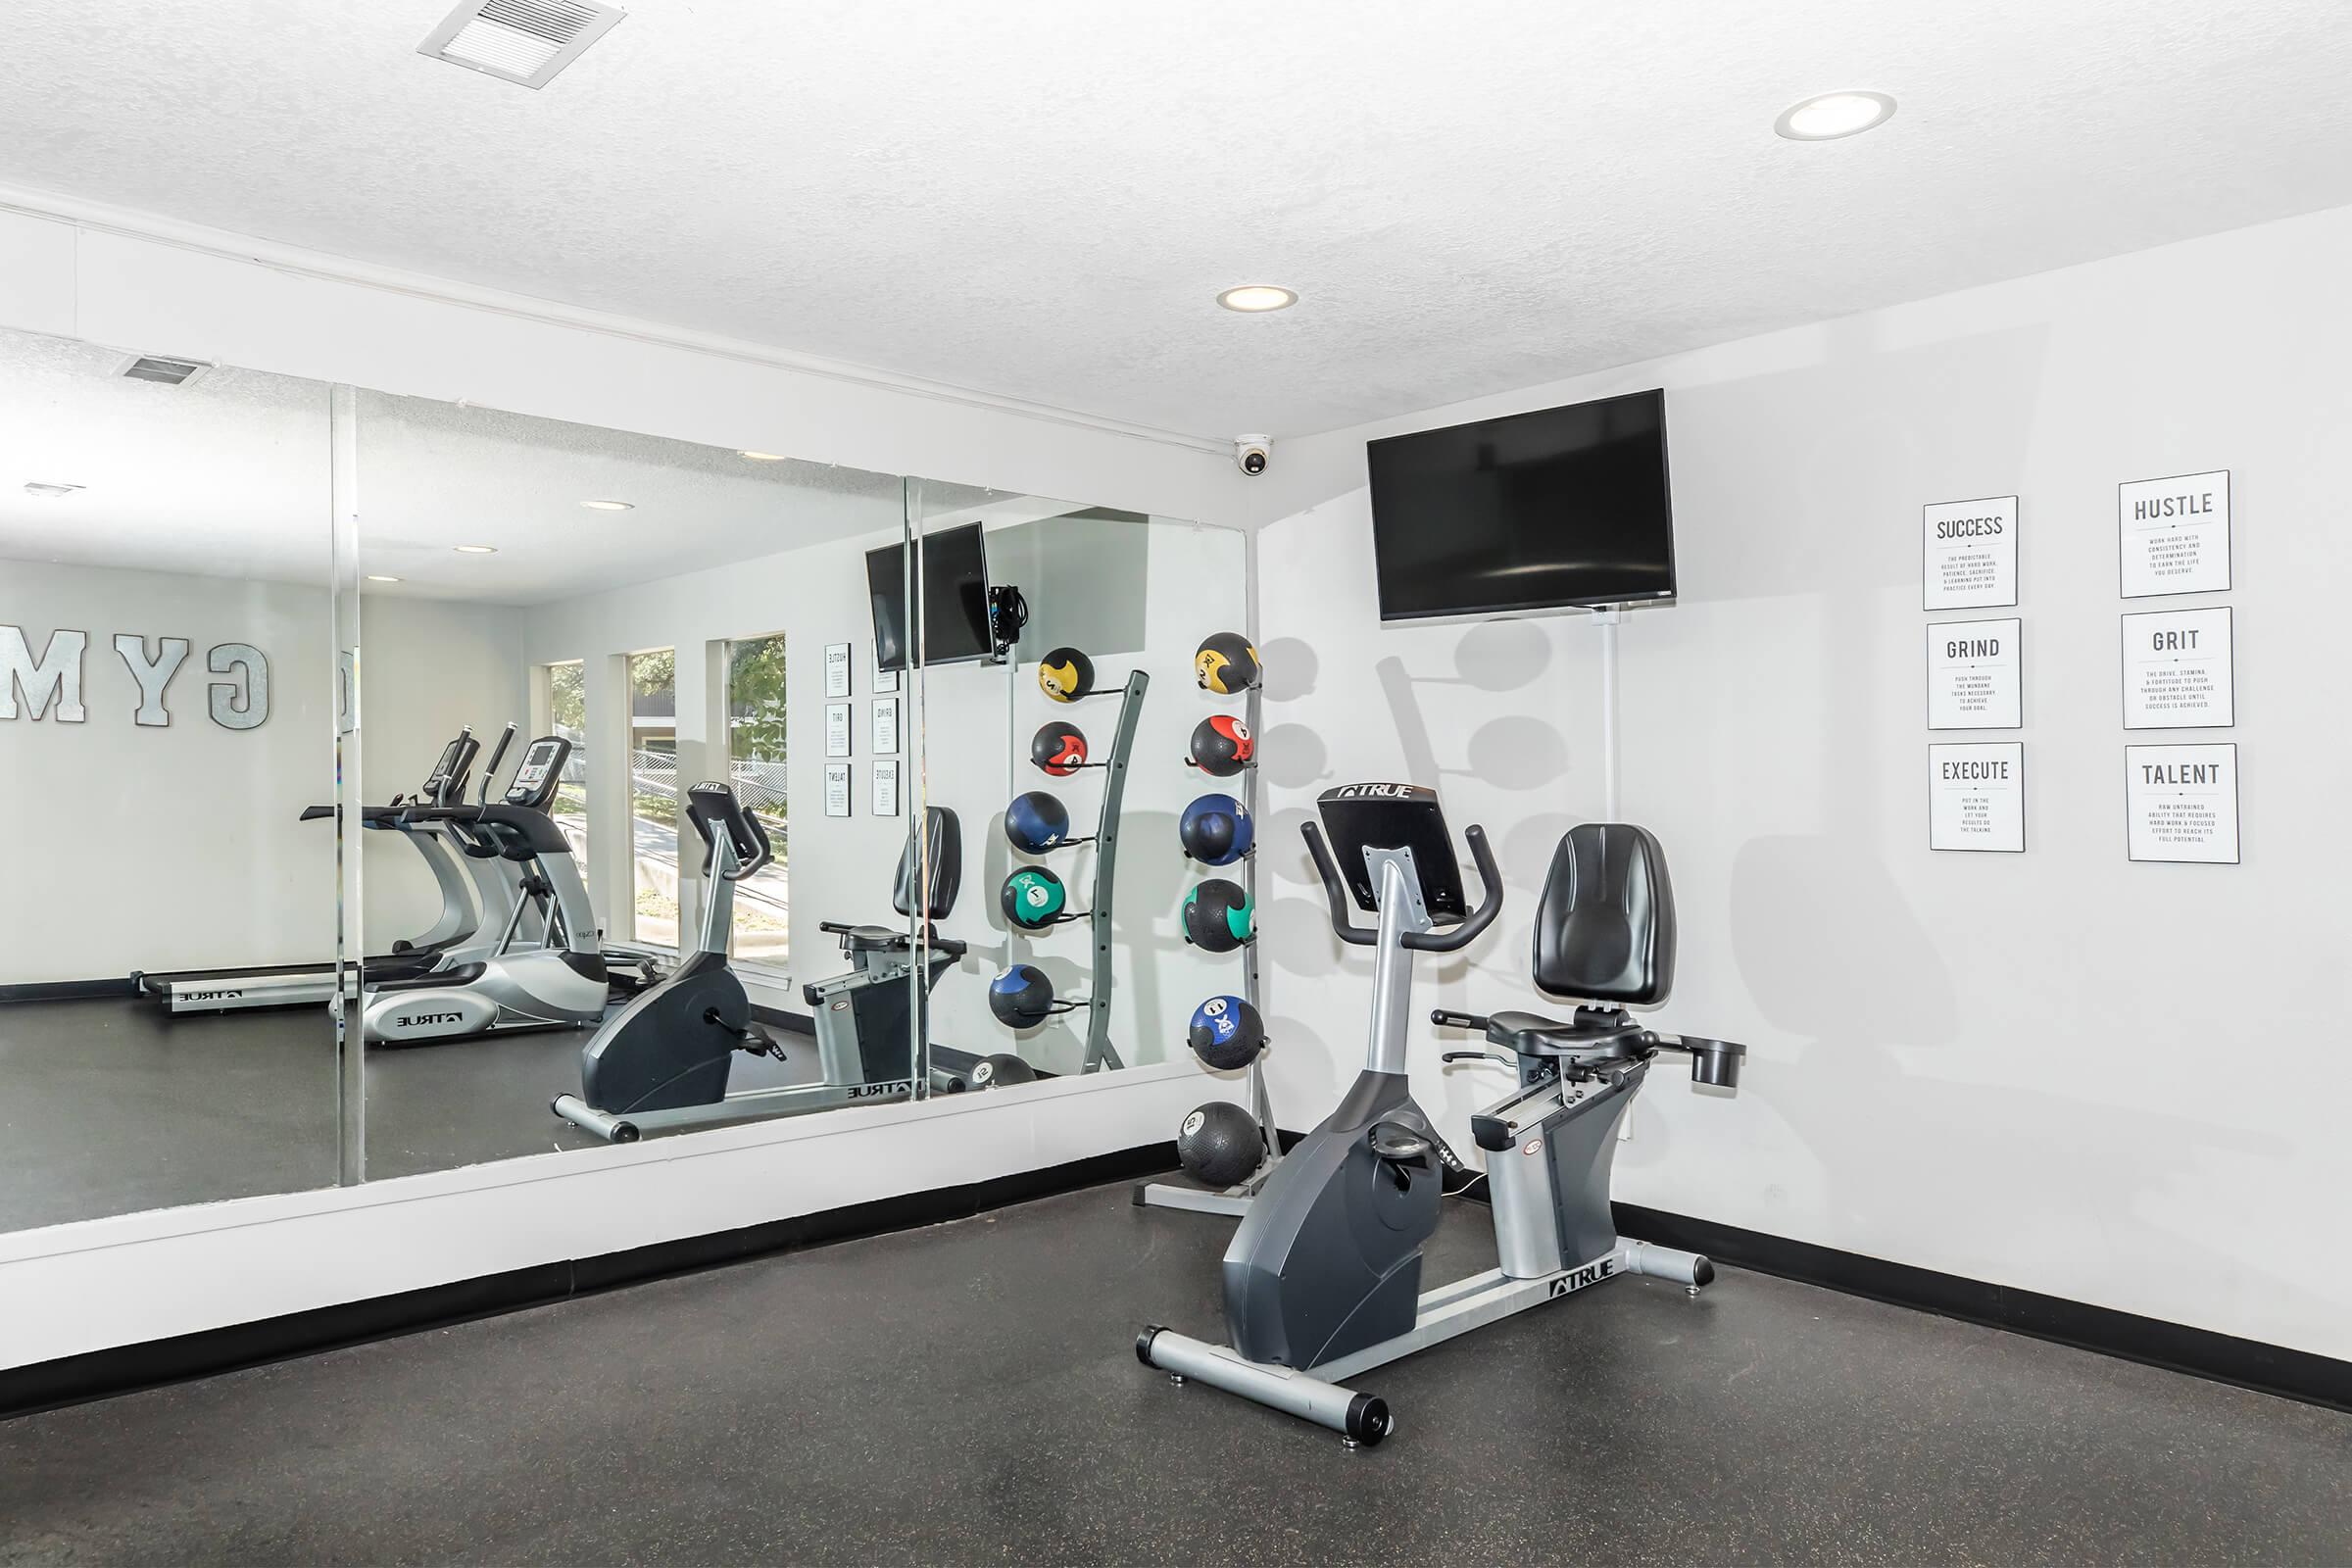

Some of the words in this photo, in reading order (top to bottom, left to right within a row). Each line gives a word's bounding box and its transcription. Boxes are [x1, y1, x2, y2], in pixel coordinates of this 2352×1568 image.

[2134, 493, 2213, 520] HUSTLE
[1937, 516, 2003, 539] SUCCESS
[2148, 544, 2186, 553] CONSISTENCY
[2152, 551, 2197, 561] DETERMINATION
[1947, 639, 1999, 659] GRIND
[2153, 630, 2199, 651] GRIT
[1943, 761, 2009, 779] EXECUTE
[2142, 764, 2220, 784] TALENT
[1359, 784, 1413, 798] TRUE
[1187, 1117, 1196, 1130] 15
[1570, 1259, 1613, 1290] TRUE
